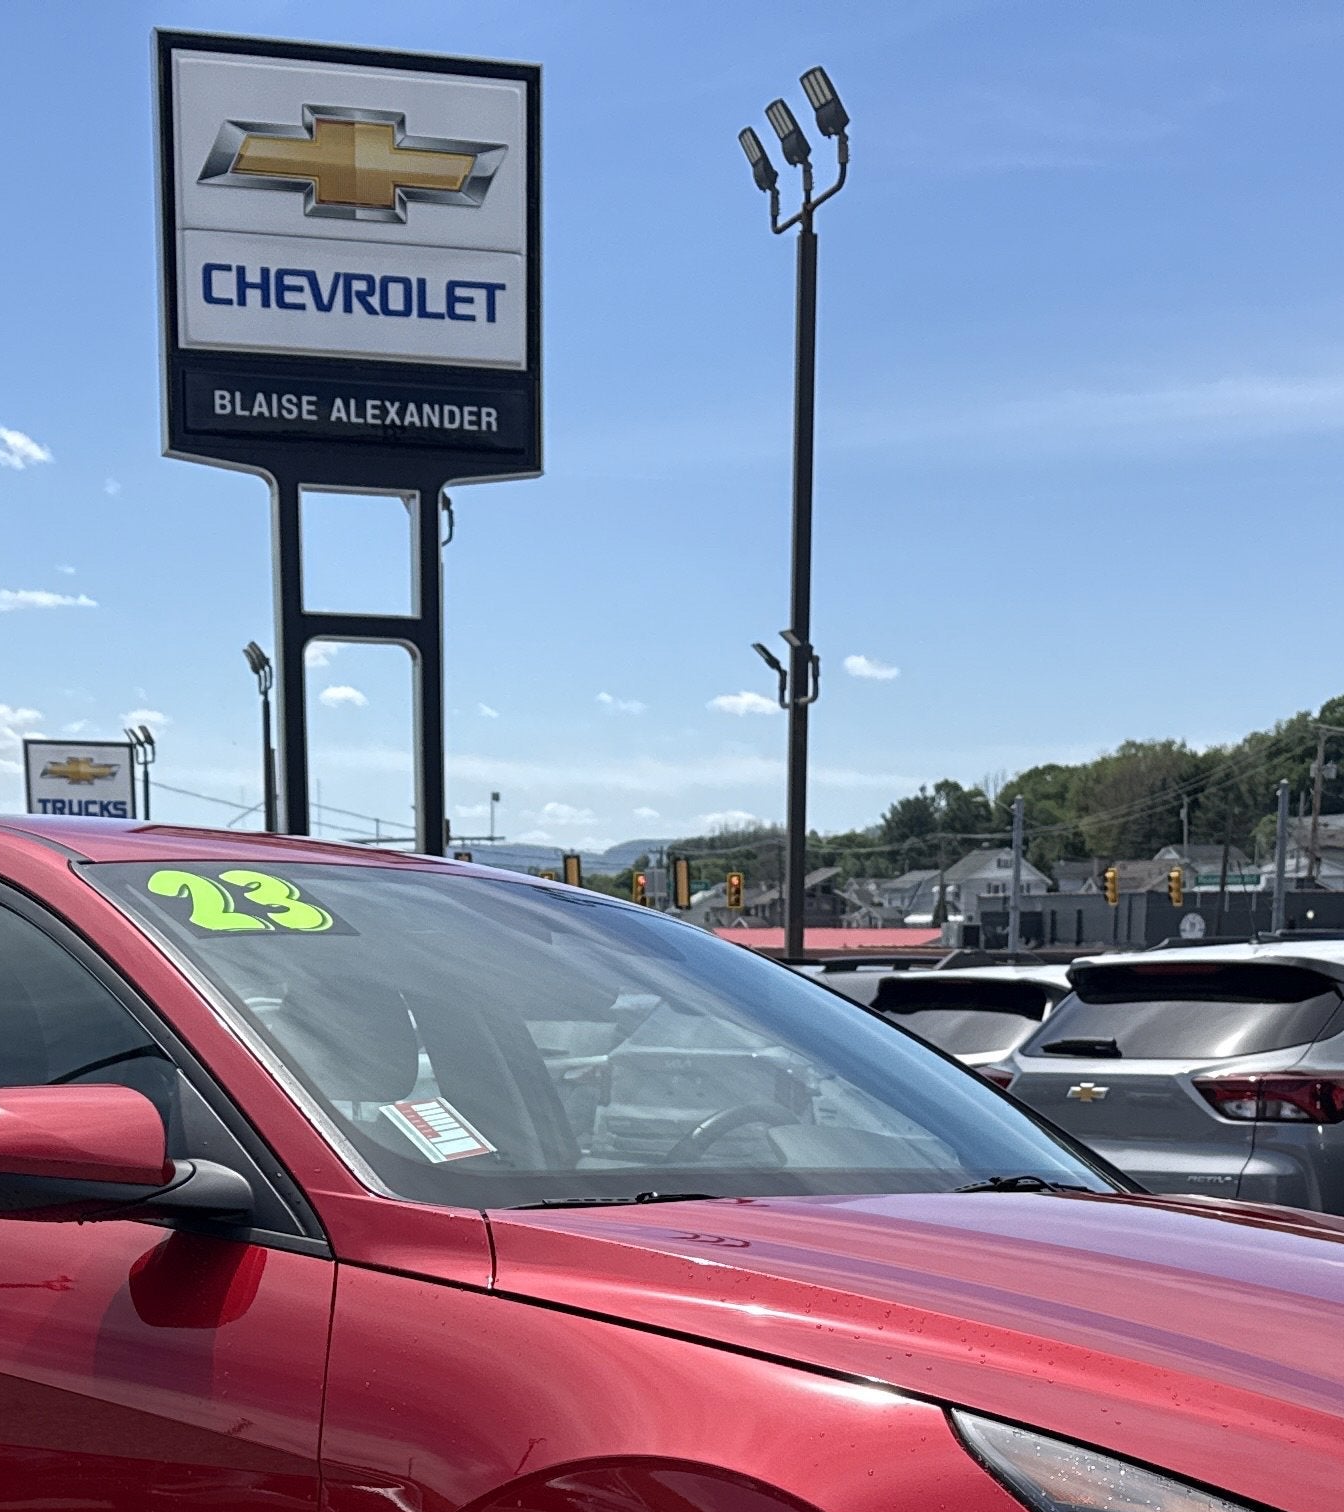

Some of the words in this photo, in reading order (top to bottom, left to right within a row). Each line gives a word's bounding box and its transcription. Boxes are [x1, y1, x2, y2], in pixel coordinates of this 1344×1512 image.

[201, 262, 506, 324] CHEVROLET
[213, 389, 318, 422] BLAISE
[330, 397, 498, 432] ALEXANDER
[37, 798, 127, 819] TRUCKS
[147, 870, 334, 932] 23
